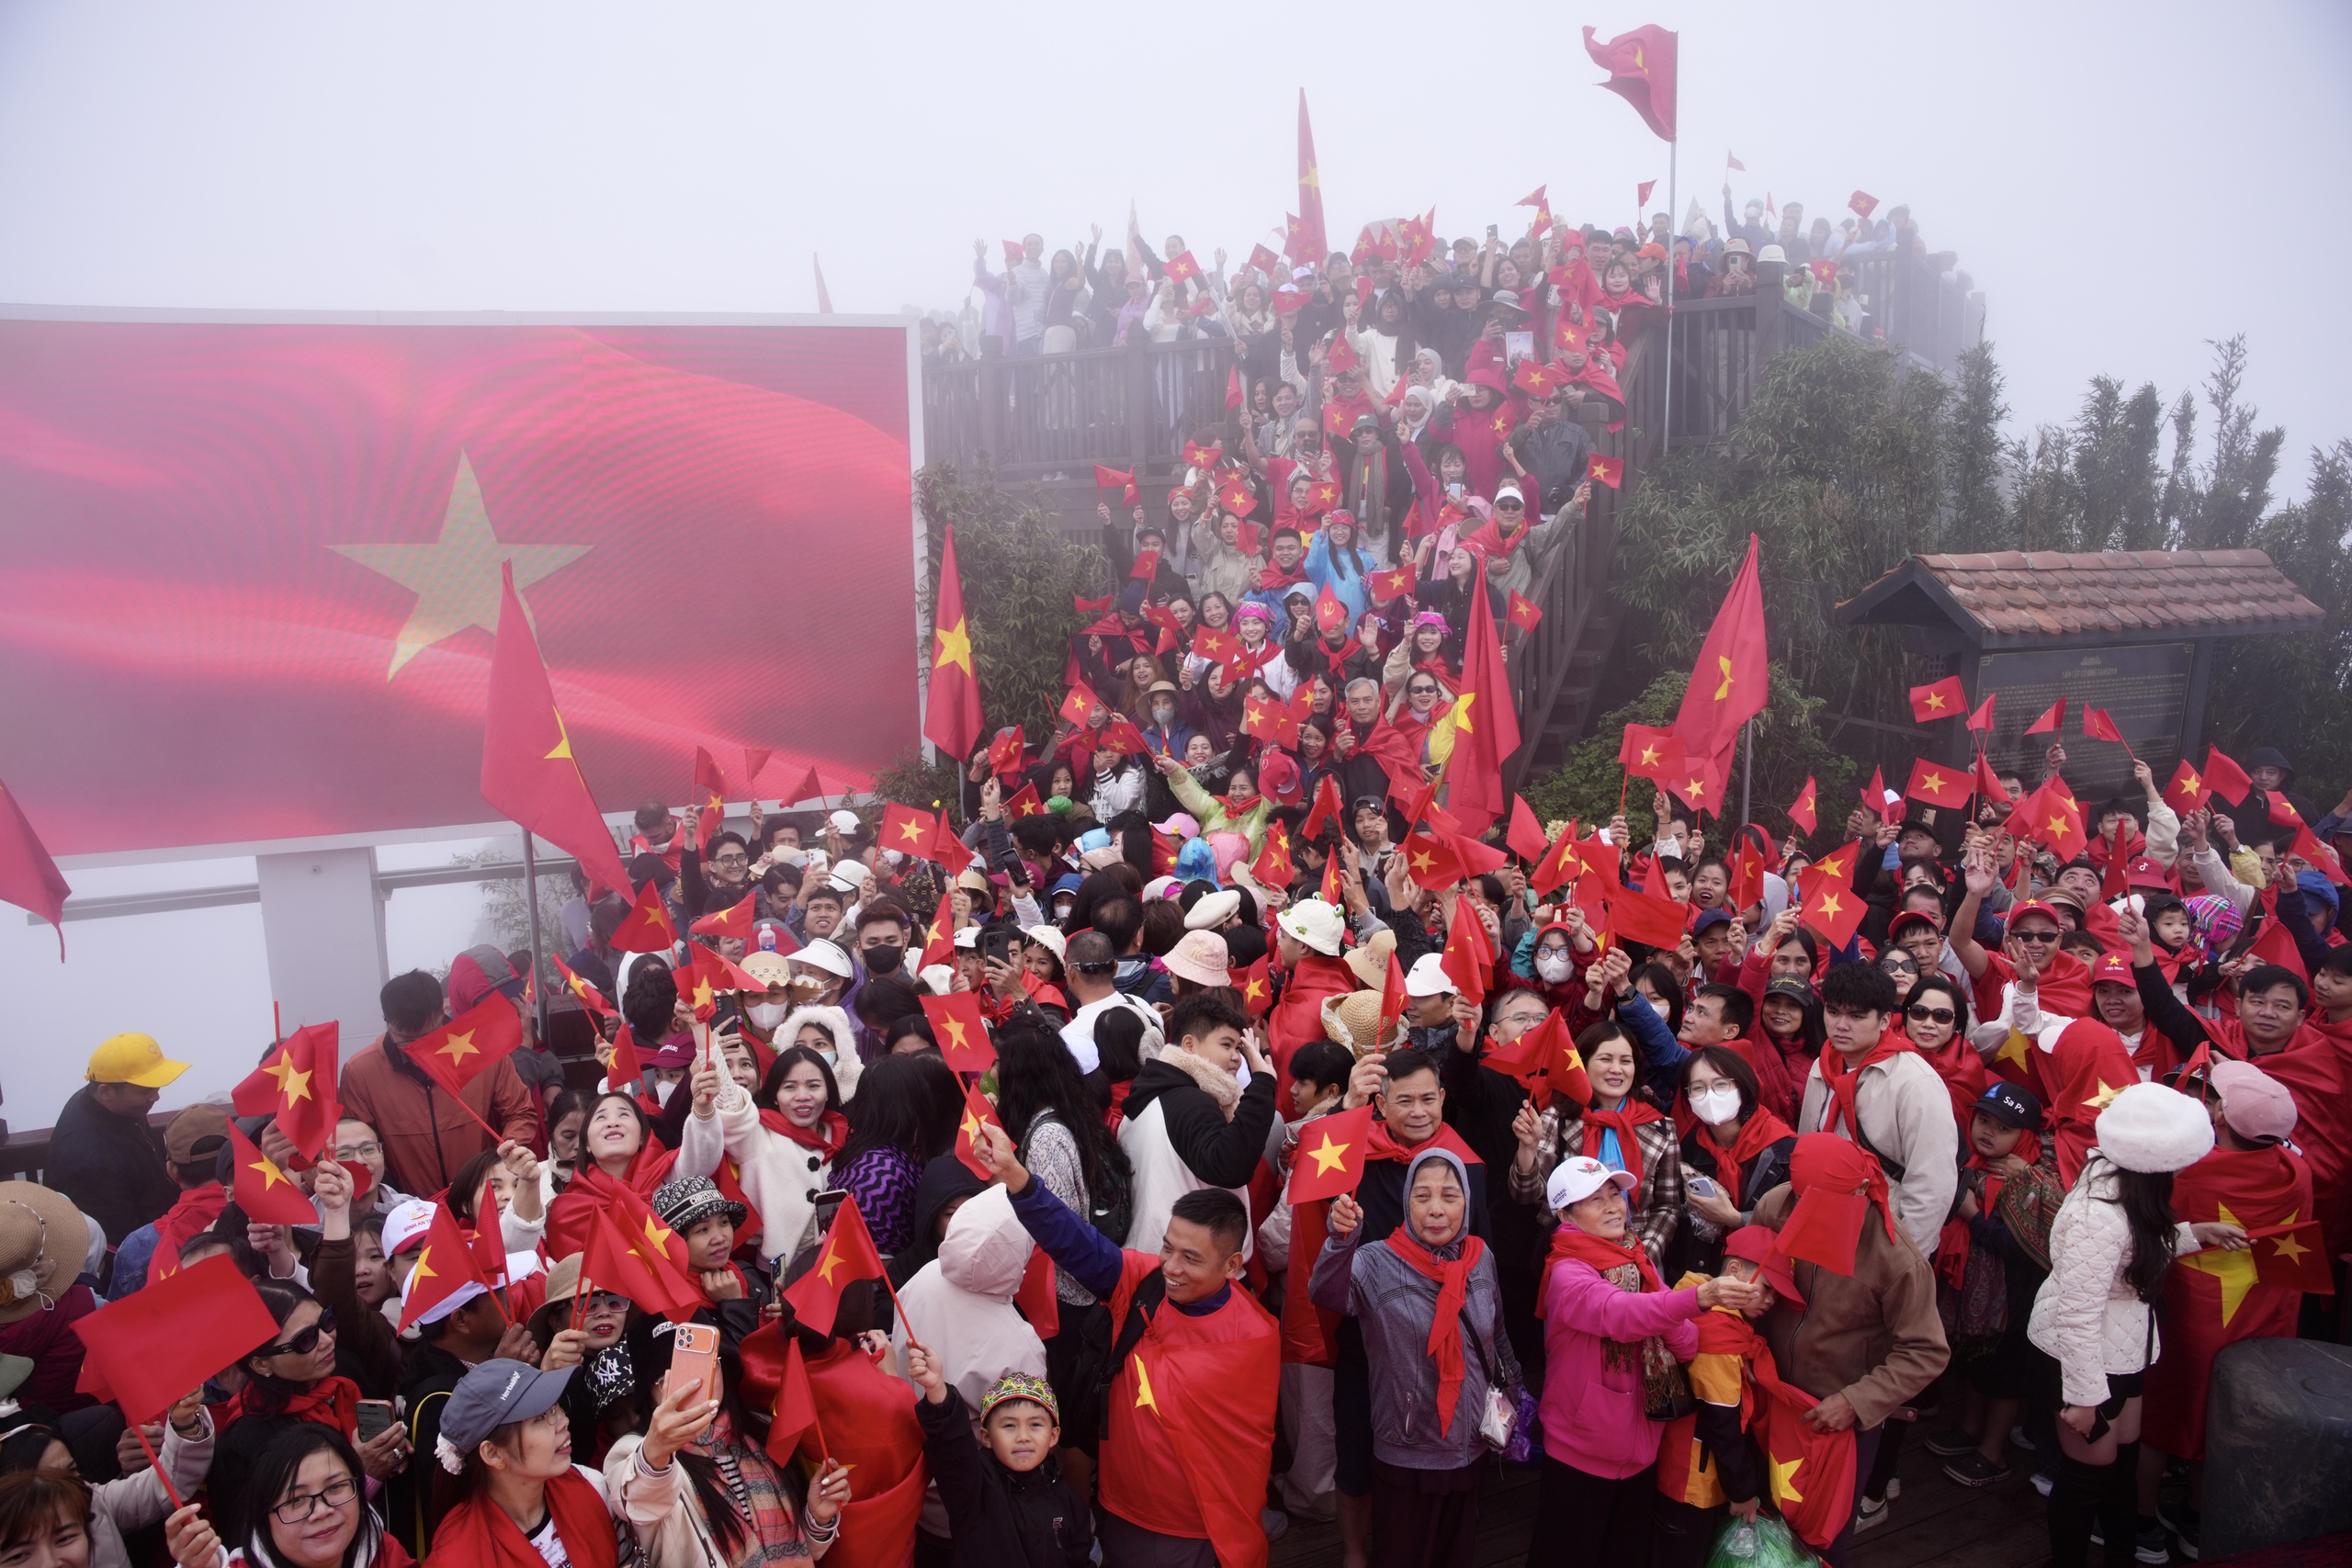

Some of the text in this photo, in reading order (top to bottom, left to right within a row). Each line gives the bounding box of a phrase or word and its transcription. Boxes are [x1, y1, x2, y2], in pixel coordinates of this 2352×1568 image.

[2003, 1096, 2026, 1114] Sa Pa
[403, 1223, 418, 1233] BÌNH
[417, 1220, 425, 1228] AN
[1969, 1476, 1997, 1487] crocs
